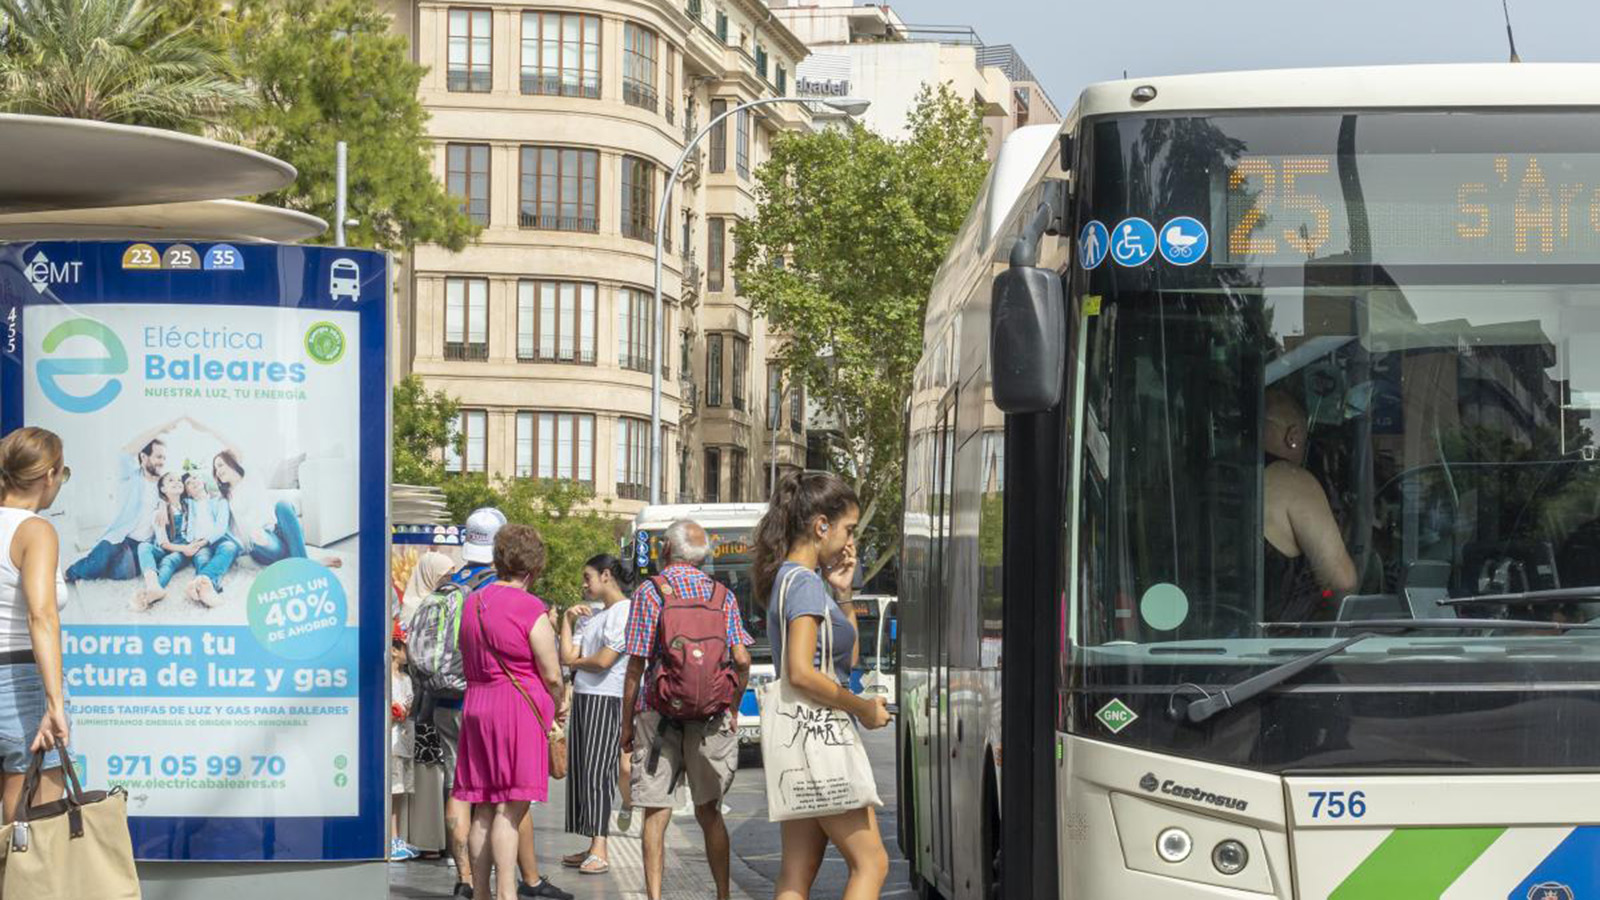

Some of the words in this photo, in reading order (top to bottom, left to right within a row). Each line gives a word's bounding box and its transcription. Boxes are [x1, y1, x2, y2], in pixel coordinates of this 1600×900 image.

[795, 76, 848, 97] abadell
[1229, 156, 1331, 255] 25
[131, 249, 153, 264] 23
[170, 250, 192, 265] 25
[212, 250, 235, 265] 35
[144, 326, 263, 349] Eléctrica
[145, 353, 306, 383] Baleares
[144, 387, 201, 398] NUESTRA
[205, 388, 231, 399] LUZ,
[234, 388, 250, 399] TU
[257, 584, 305, 604] HASTA
[307, 577, 329, 591] UN
[265, 590, 336, 626] 40%
[268, 629, 285, 641] DE
[288, 616, 337, 637] AHORRO
[61, 630, 143, 655] horra
[153, 635, 192, 655] en
[201, 631, 236, 656] tu
[66, 662, 147, 687] ctura
[157, 662, 198, 687] de
[207, 662, 256, 688] luz
[264, 667, 284, 692] y
[294, 667, 348, 692] gas
[117, 705, 166, 715] TARIFAS
[169, 705, 185, 715] DE
[188, 705, 212, 715] LUZ
[215, 706, 223, 715] Y
[225, 706, 251, 715] GAS
[254, 706, 286, 716] PARA
[289, 706, 349, 716] BALEARES
[1104, 710, 1128, 721] GNC
[107, 755, 151, 776] 971
[160, 755, 197, 776] 05
[206, 755, 242, 776] 99
[251, 755, 286, 776] 70
[107, 778, 286, 790] www.electricabaleares.es
[1160, 779, 1249, 812] Castrosua
[1307, 790, 1367, 818] 756
